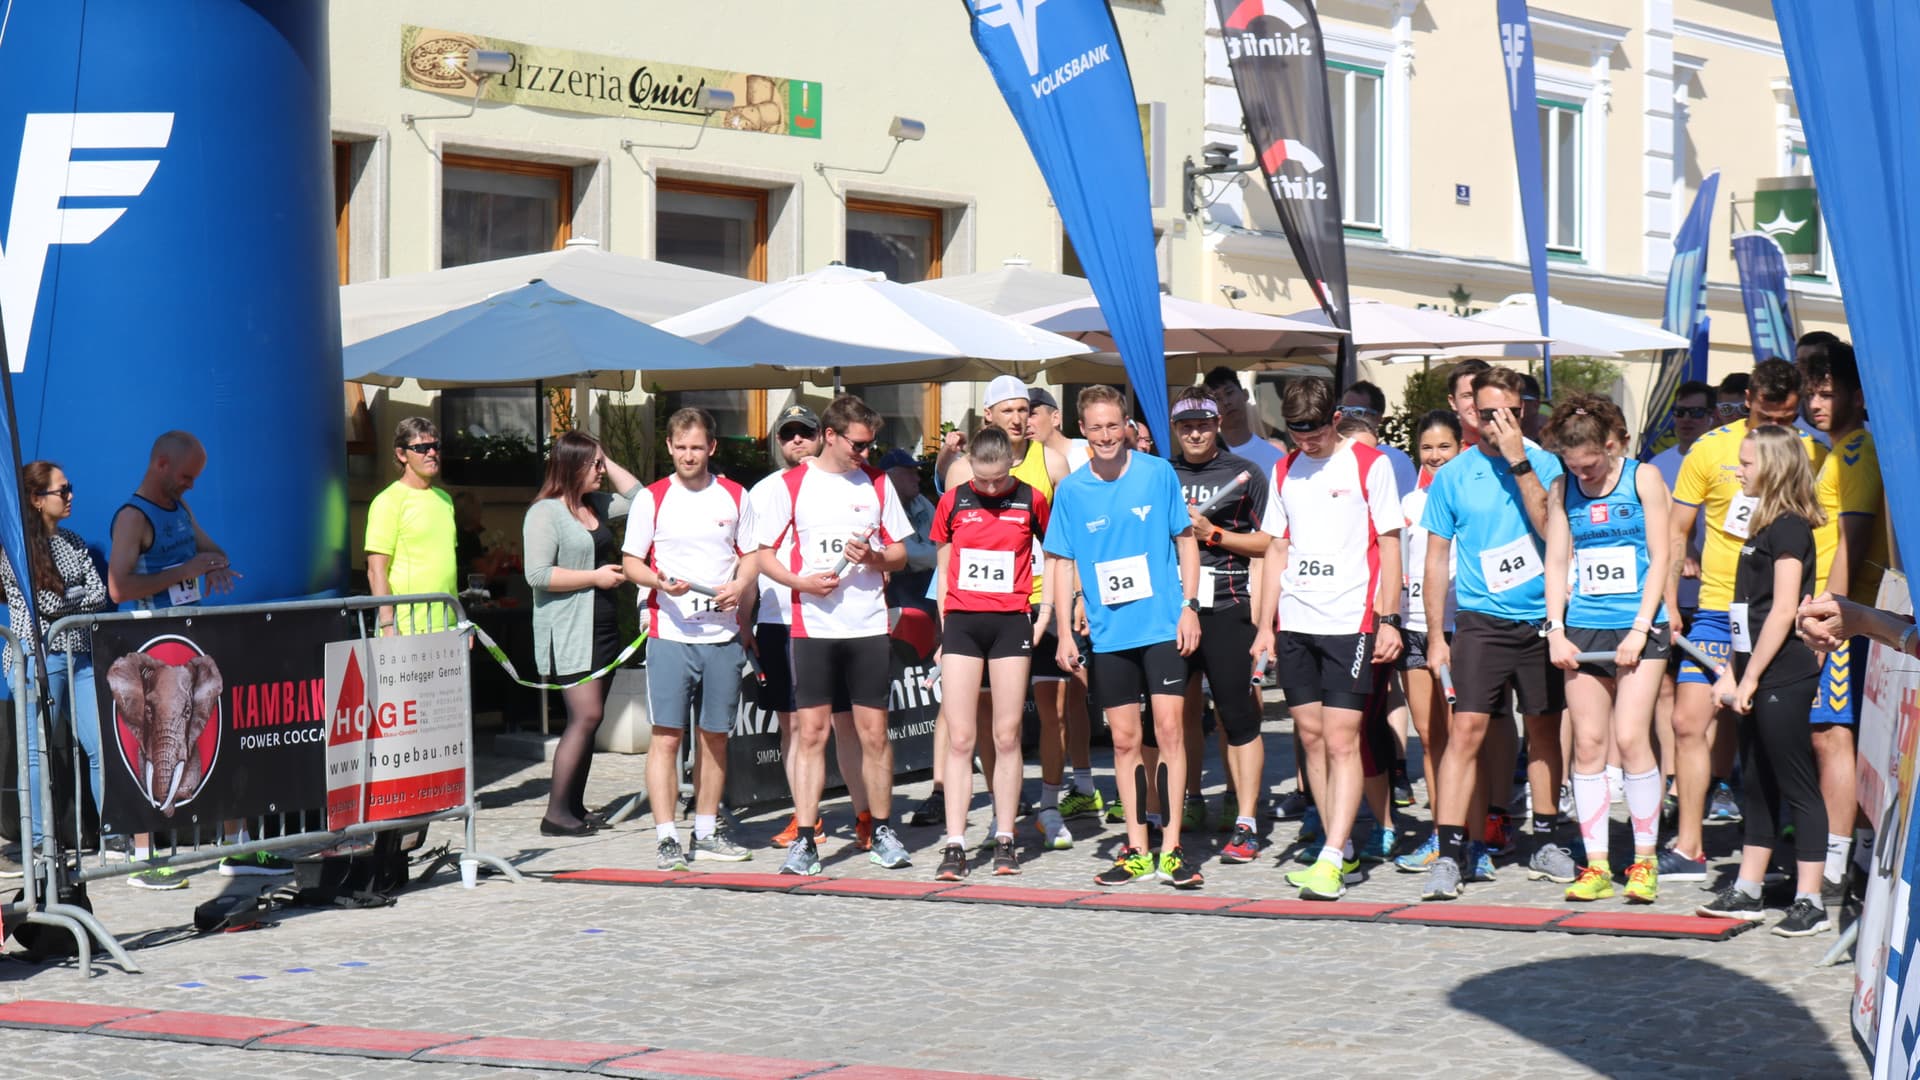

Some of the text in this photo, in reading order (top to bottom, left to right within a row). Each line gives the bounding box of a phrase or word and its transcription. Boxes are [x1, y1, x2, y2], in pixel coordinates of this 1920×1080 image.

[1031, 44, 1110, 99] VOLKSBANK
[1459, 187, 1467, 196] 3
[819, 538, 848, 554] 16
[967, 563, 1005, 581] 21a
[1298, 560, 1335, 577] 26a
[1499, 555, 1526, 573] 4a
[1586, 563, 1625, 581] 19a
[1108, 575, 1135, 592] 3a
[1692, 641, 1730, 656] ACU
[379, 666, 461, 686] Ing. Hofegger Gernot
[336, 700, 417, 736] HOGE
[241, 732, 280, 750] POWER
[330, 741, 463, 775] wwwhogebau.net
[756, 749, 782, 765] SIMPLY
[369, 793, 406, 806] bauen
